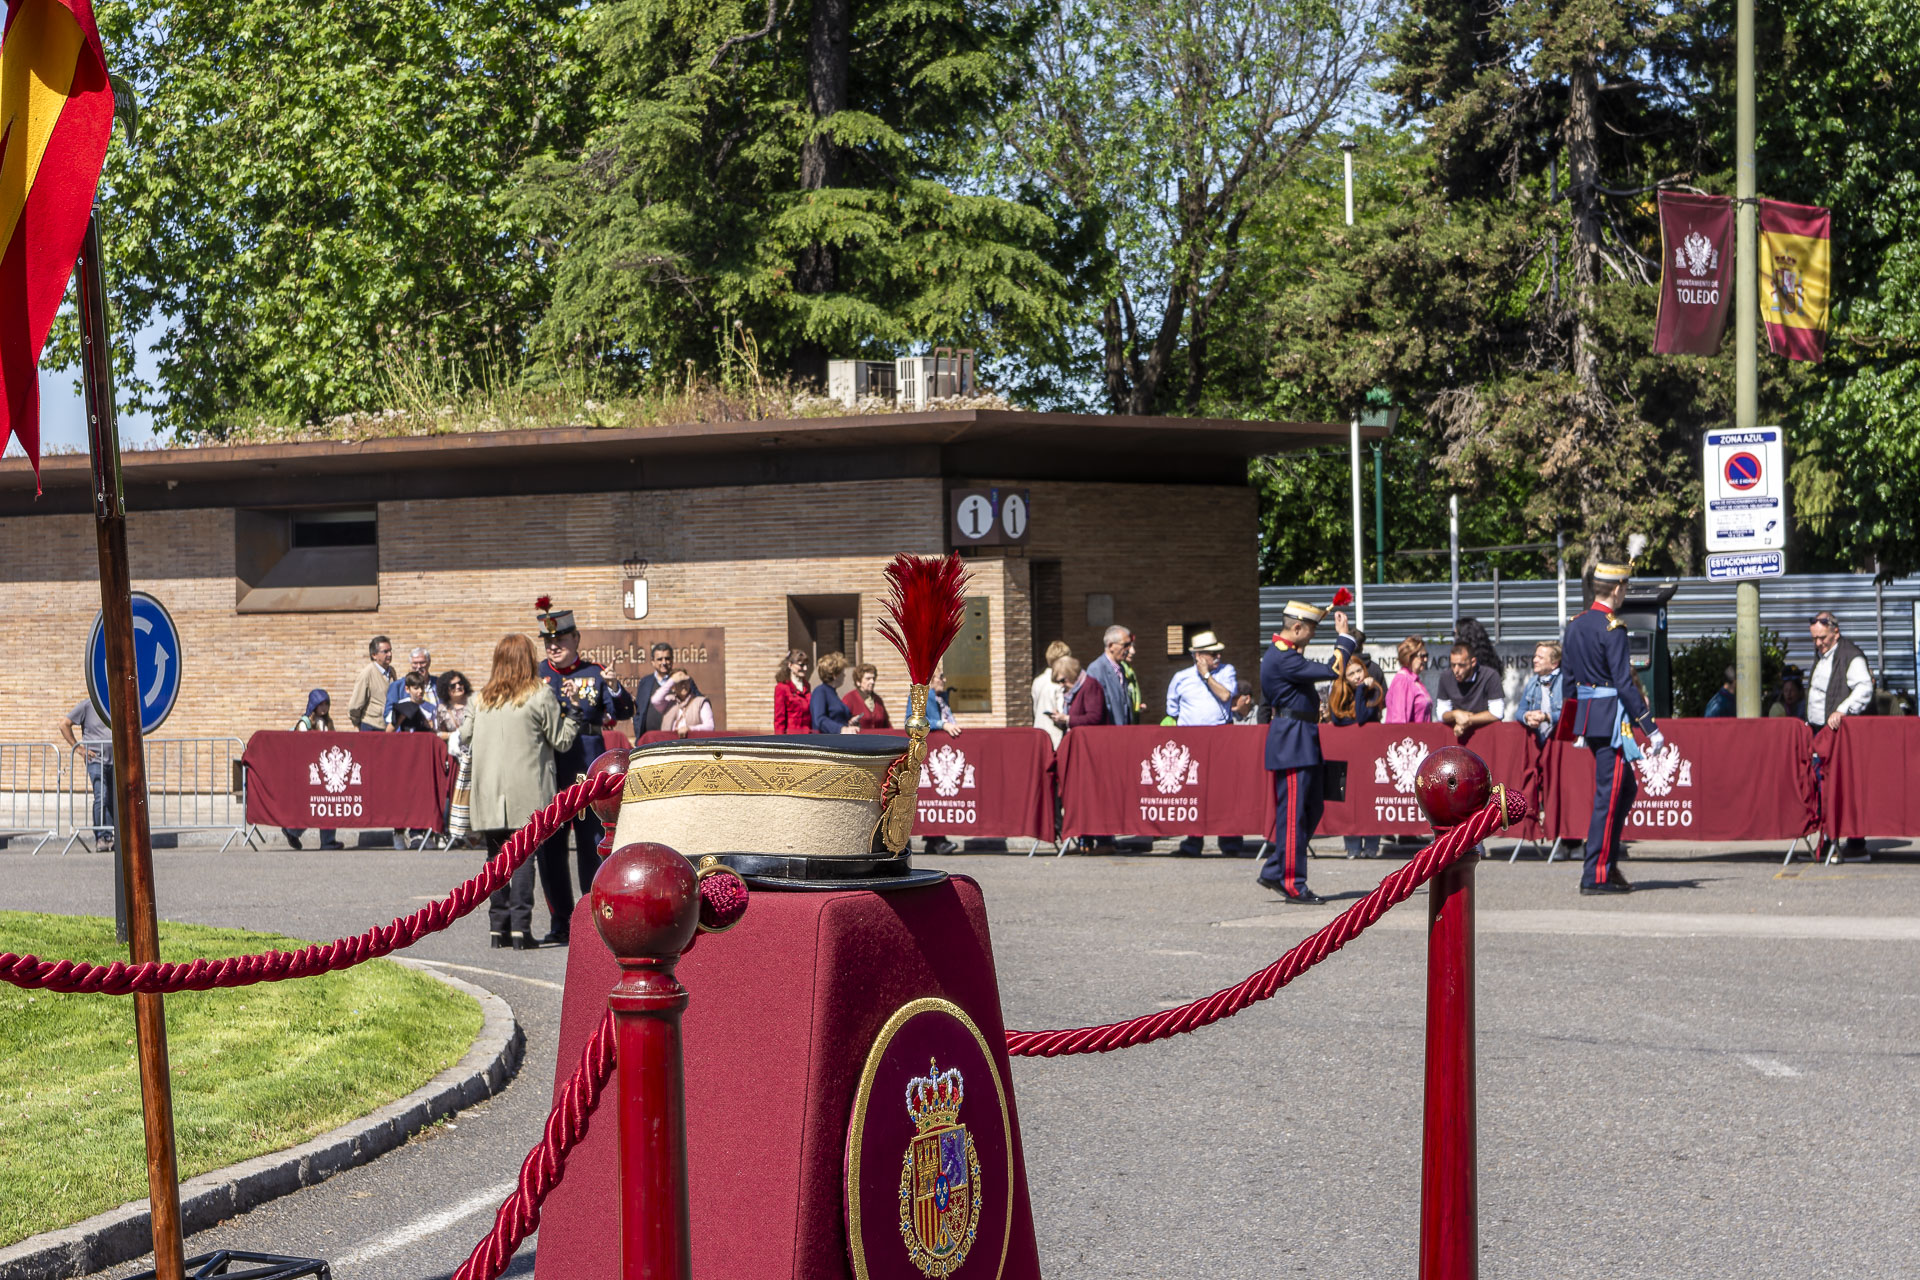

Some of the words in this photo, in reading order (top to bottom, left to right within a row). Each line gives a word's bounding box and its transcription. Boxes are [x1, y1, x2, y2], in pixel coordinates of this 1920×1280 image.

[1677, 288, 1719, 305] TOLEDO
[1720, 435, 1742, 444] ZONA
[1743, 433, 1764, 443] AZUL
[1711, 555, 1778, 568] ESTACIONAMIENTO
[1726, 567, 1738, 577] EN
[579, 644, 645, 664] astilla-La
[310, 795, 352, 803] AYUNTAMIENTO
[354, 795, 362, 803] DE
[918, 800, 965, 808] AYUNTAMIENTO
[966, 800, 976, 808] DE
[1140, 797, 1188, 805] AYUNTAMIENTO
[1189, 797, 1198, 805] DE
[1631, 800, 1680, 809] UNTAMIENTO
[1681, 800, 1693, 809] DE
[310, 803, 363, 817] TOLEDO
[917, 808, 976, 824] TOLEDO
[1140, 806, 1198, 822] TOLEDO
[1375, 806, 1428, 822] TOLED
